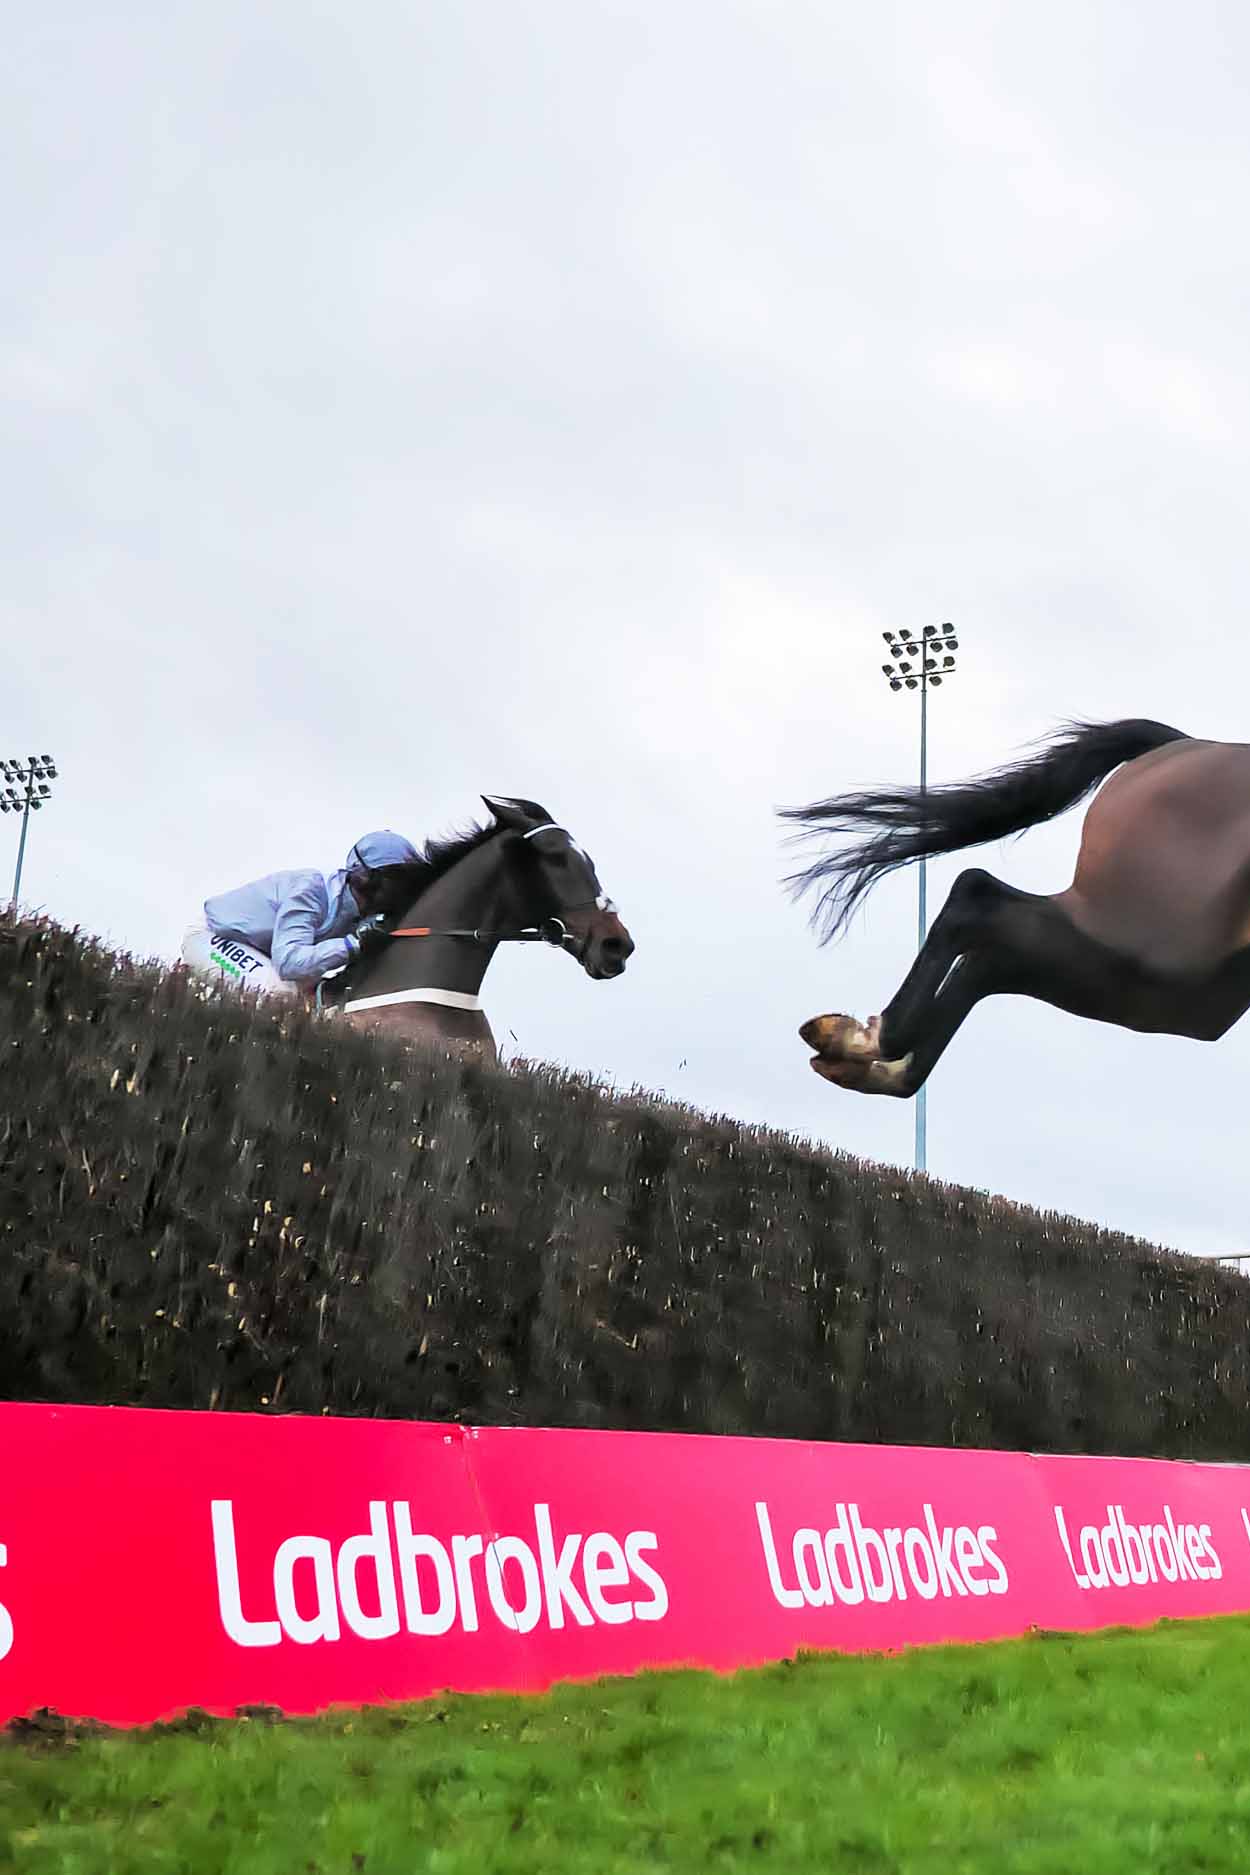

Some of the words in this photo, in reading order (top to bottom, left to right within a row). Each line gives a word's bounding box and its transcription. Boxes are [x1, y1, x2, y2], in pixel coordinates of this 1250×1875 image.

[210, 935, 264, 973] UNIBET
[211, 1500, 669, 1647] Ladbrokes
[755, 1502, 1009, 1609] Ladbrokes
[1054, 1505, 1223, 1590] Ladbrokes
